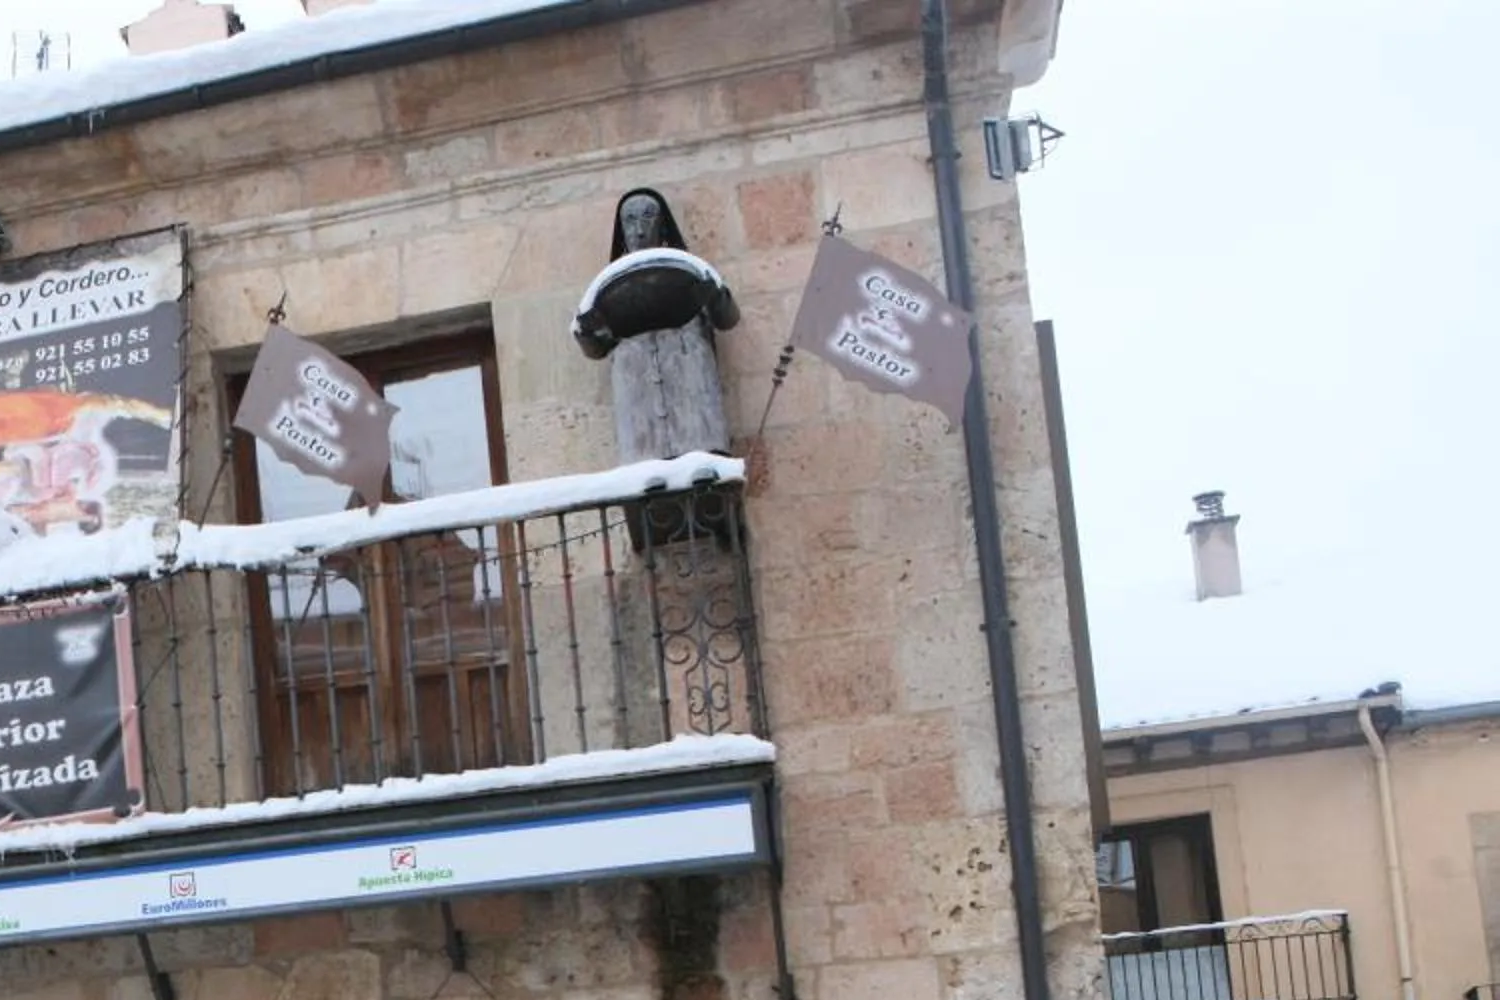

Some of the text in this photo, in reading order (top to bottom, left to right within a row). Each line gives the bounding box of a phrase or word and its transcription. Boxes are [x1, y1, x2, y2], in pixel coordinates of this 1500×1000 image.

[18, 287, 32, 308] y
[39, 265, 149, 299] Cordero...
[865, 275, 921, 315] Casa
[31, 289, 145, 328] LLEVAR
[36, 327, 149, 361] 921 55 10 55
[838, 331, 911, 377] Pastor
[36, 348, 149, 384] 921 55 02 83
[303, 364, 351, 402] Casa
[275, 415, 337, 461] Pastor
